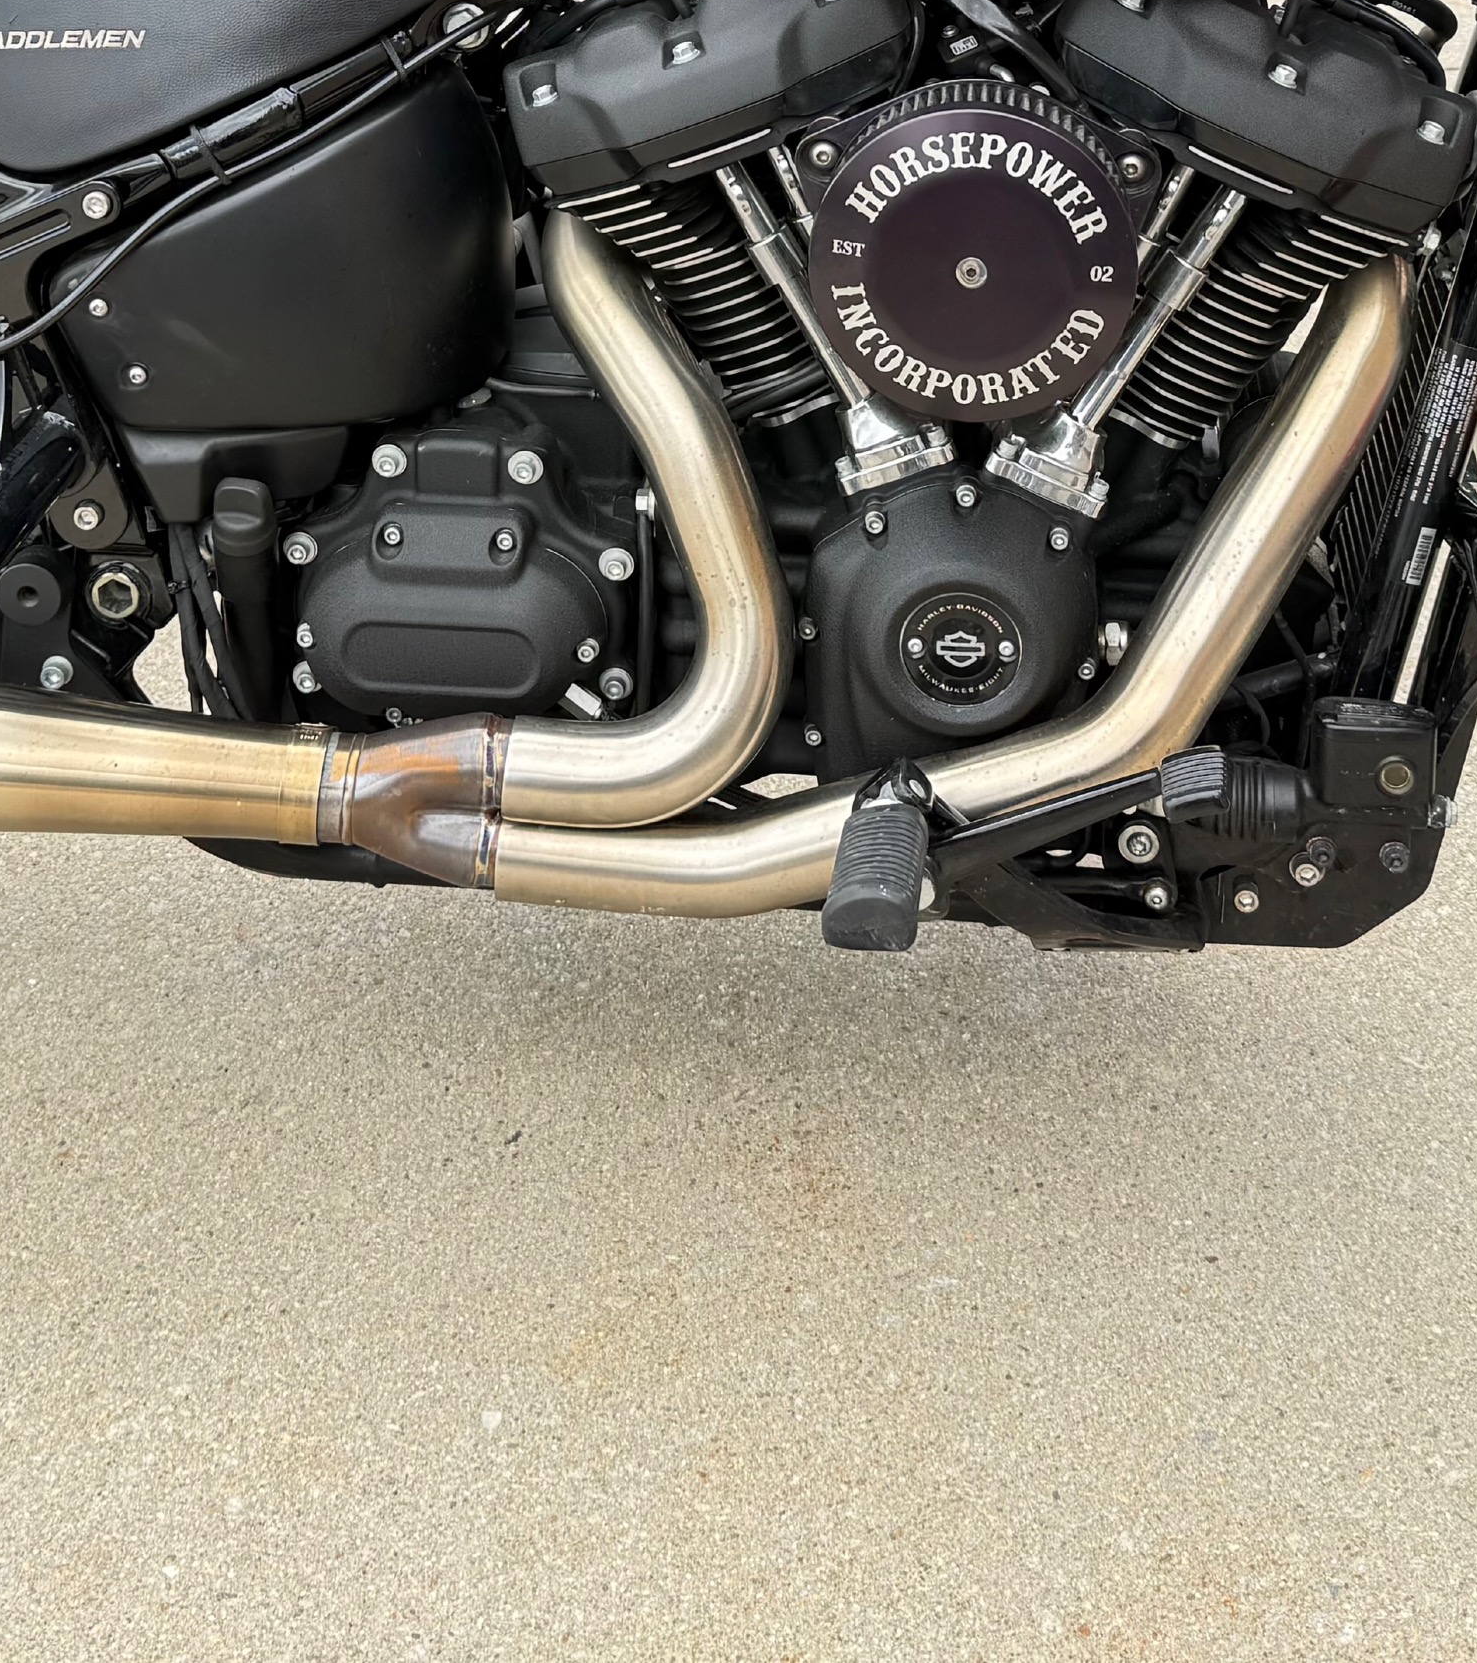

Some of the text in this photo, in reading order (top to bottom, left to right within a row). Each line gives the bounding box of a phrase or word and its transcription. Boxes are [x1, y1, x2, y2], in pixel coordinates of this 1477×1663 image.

[845, 132, 1108, 245] HORSEPOWER
[832, 239, 865, 257] EST
[1090, 265, 1114, 282] 02
[831, 282, 1104, 405] INCORPORATED
